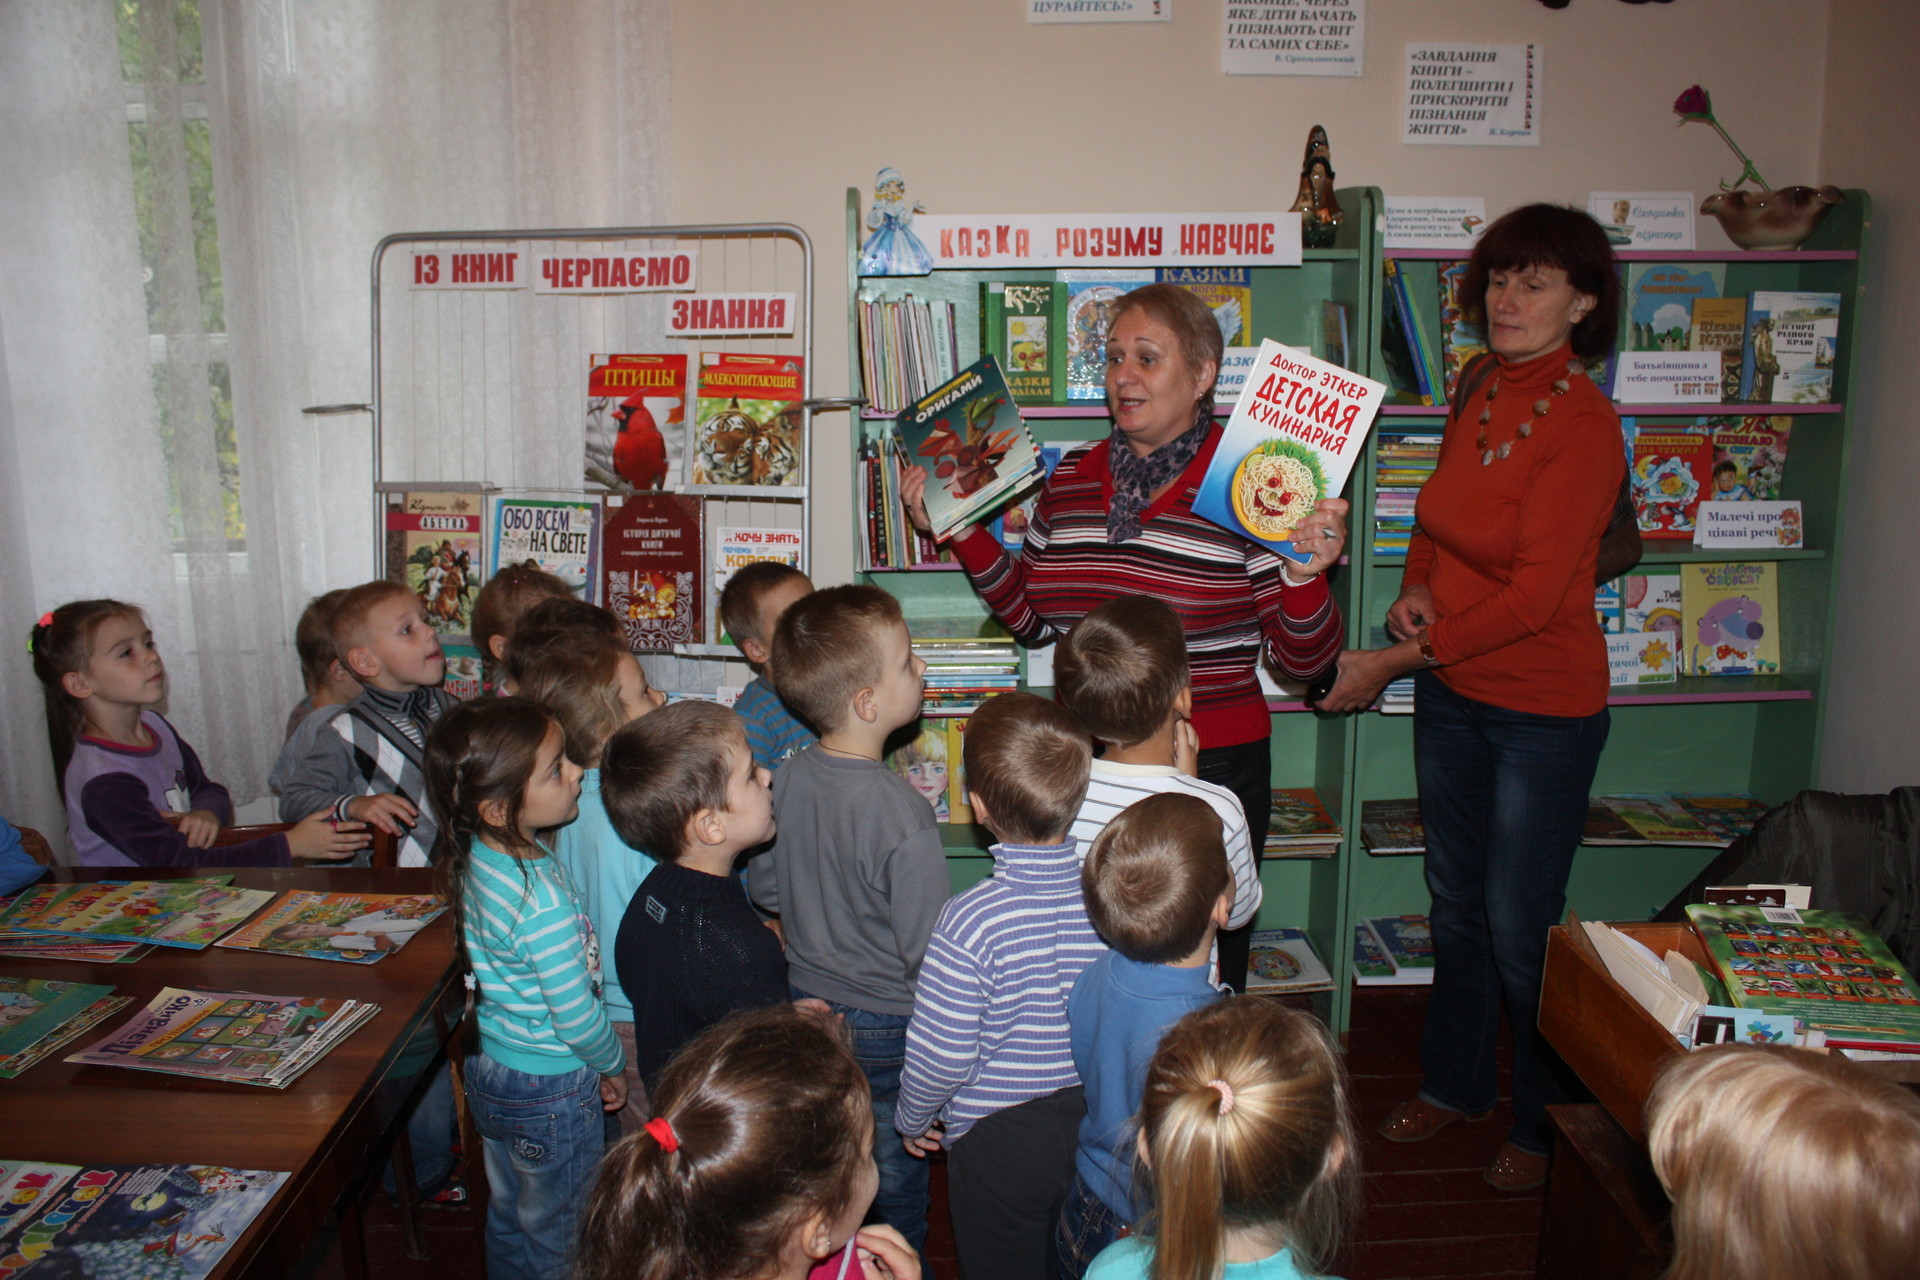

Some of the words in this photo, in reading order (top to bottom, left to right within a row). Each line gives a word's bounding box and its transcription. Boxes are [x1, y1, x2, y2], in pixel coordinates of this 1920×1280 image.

[1227, 9, 1258, 19] ЯКЕ
[1259, 9, 1297, 21] ДІТИ
[1299, 10, 1357, 21] БАЧАТЬ
[1236, 24, 1317, 35] ПІЗНАЮТЬ
[1319, 25, 1354, 36] СВІТ
[1228, 38, 1246, 49] ТА
[1249, 39, 1302, 50] САМИХ
[1305, 39, 1350, 51] СЕБЕ»
[1410, 50, 1497, 62] «ЗАВДАННЯ
[1411, 65, 1463, 76] КНИГИ
[1410, 80, 1506, 92] ПОЛЕГШИТИ
[1409, 94, 1509, 107] ПРИСКОРИТИ
[1409, 109, 1488, 121] ПІЗНАННЯ
[1408, 123, 1468, 135] ЖИТТЯ»
[940, 225, 1030, 258] КАЗКА
[1056, 226, 1163, 257] РОЗУМУ
[1180, 223, 1275, 256] НАВЧАЄ
[414, 254, 440, 285] ІЗ
[452, 252, 518, 284] КНИГ
[542, 254, 691, 289] ЧЕРПАЄМО
[1163, 268, 1246, 283] КАЗКИ
[671, 298, 786, 331] ЗНАННЯ
[1699, 333, 1743, 347] ІСТОР
[1221, 356, 1256, 367] АЗК
[1634, 360, 1700, 370] Батьківщина
[603, 368, 676, 388] ПТИЦЫ
[703, 373, 797, 389] МЛЕКОПИТАЮЩИЕ
[1269, 353, 1317, 381] ДОКТОР
[1320, 371, 1368, 401] ЭТКЕР
[1626, 374, 1648, 383] тебе
[1650, 374, 1715, 383] починається
[1009, 386, 1051, 396] ОДІЛЛЯ
[915, 374, 983, 424] ОРИГАМИ
[1256, 372, 1361, 436] ДЕТСКАЯ
[1247, 399, 1348, 456] КУЛИНАРИЯ
[503, 508, 533, 530] ОБО
[1707, 511, 1756, 522] Малечі
[1757, 513, 1782, 524] про
[734, 532, 762, 543] ХОЧУ
[765, 533, 800, 544] ЗНАТЬ
[1707, 527, 1749, 539] цікаві
[1750, 527, 1778, 540] речі
[529, 531, 548, 553] НА
[551, 532, 587, 555] СВЕТЕ
[0, 1169, 118, 1280] ОЛОБОЧОК
